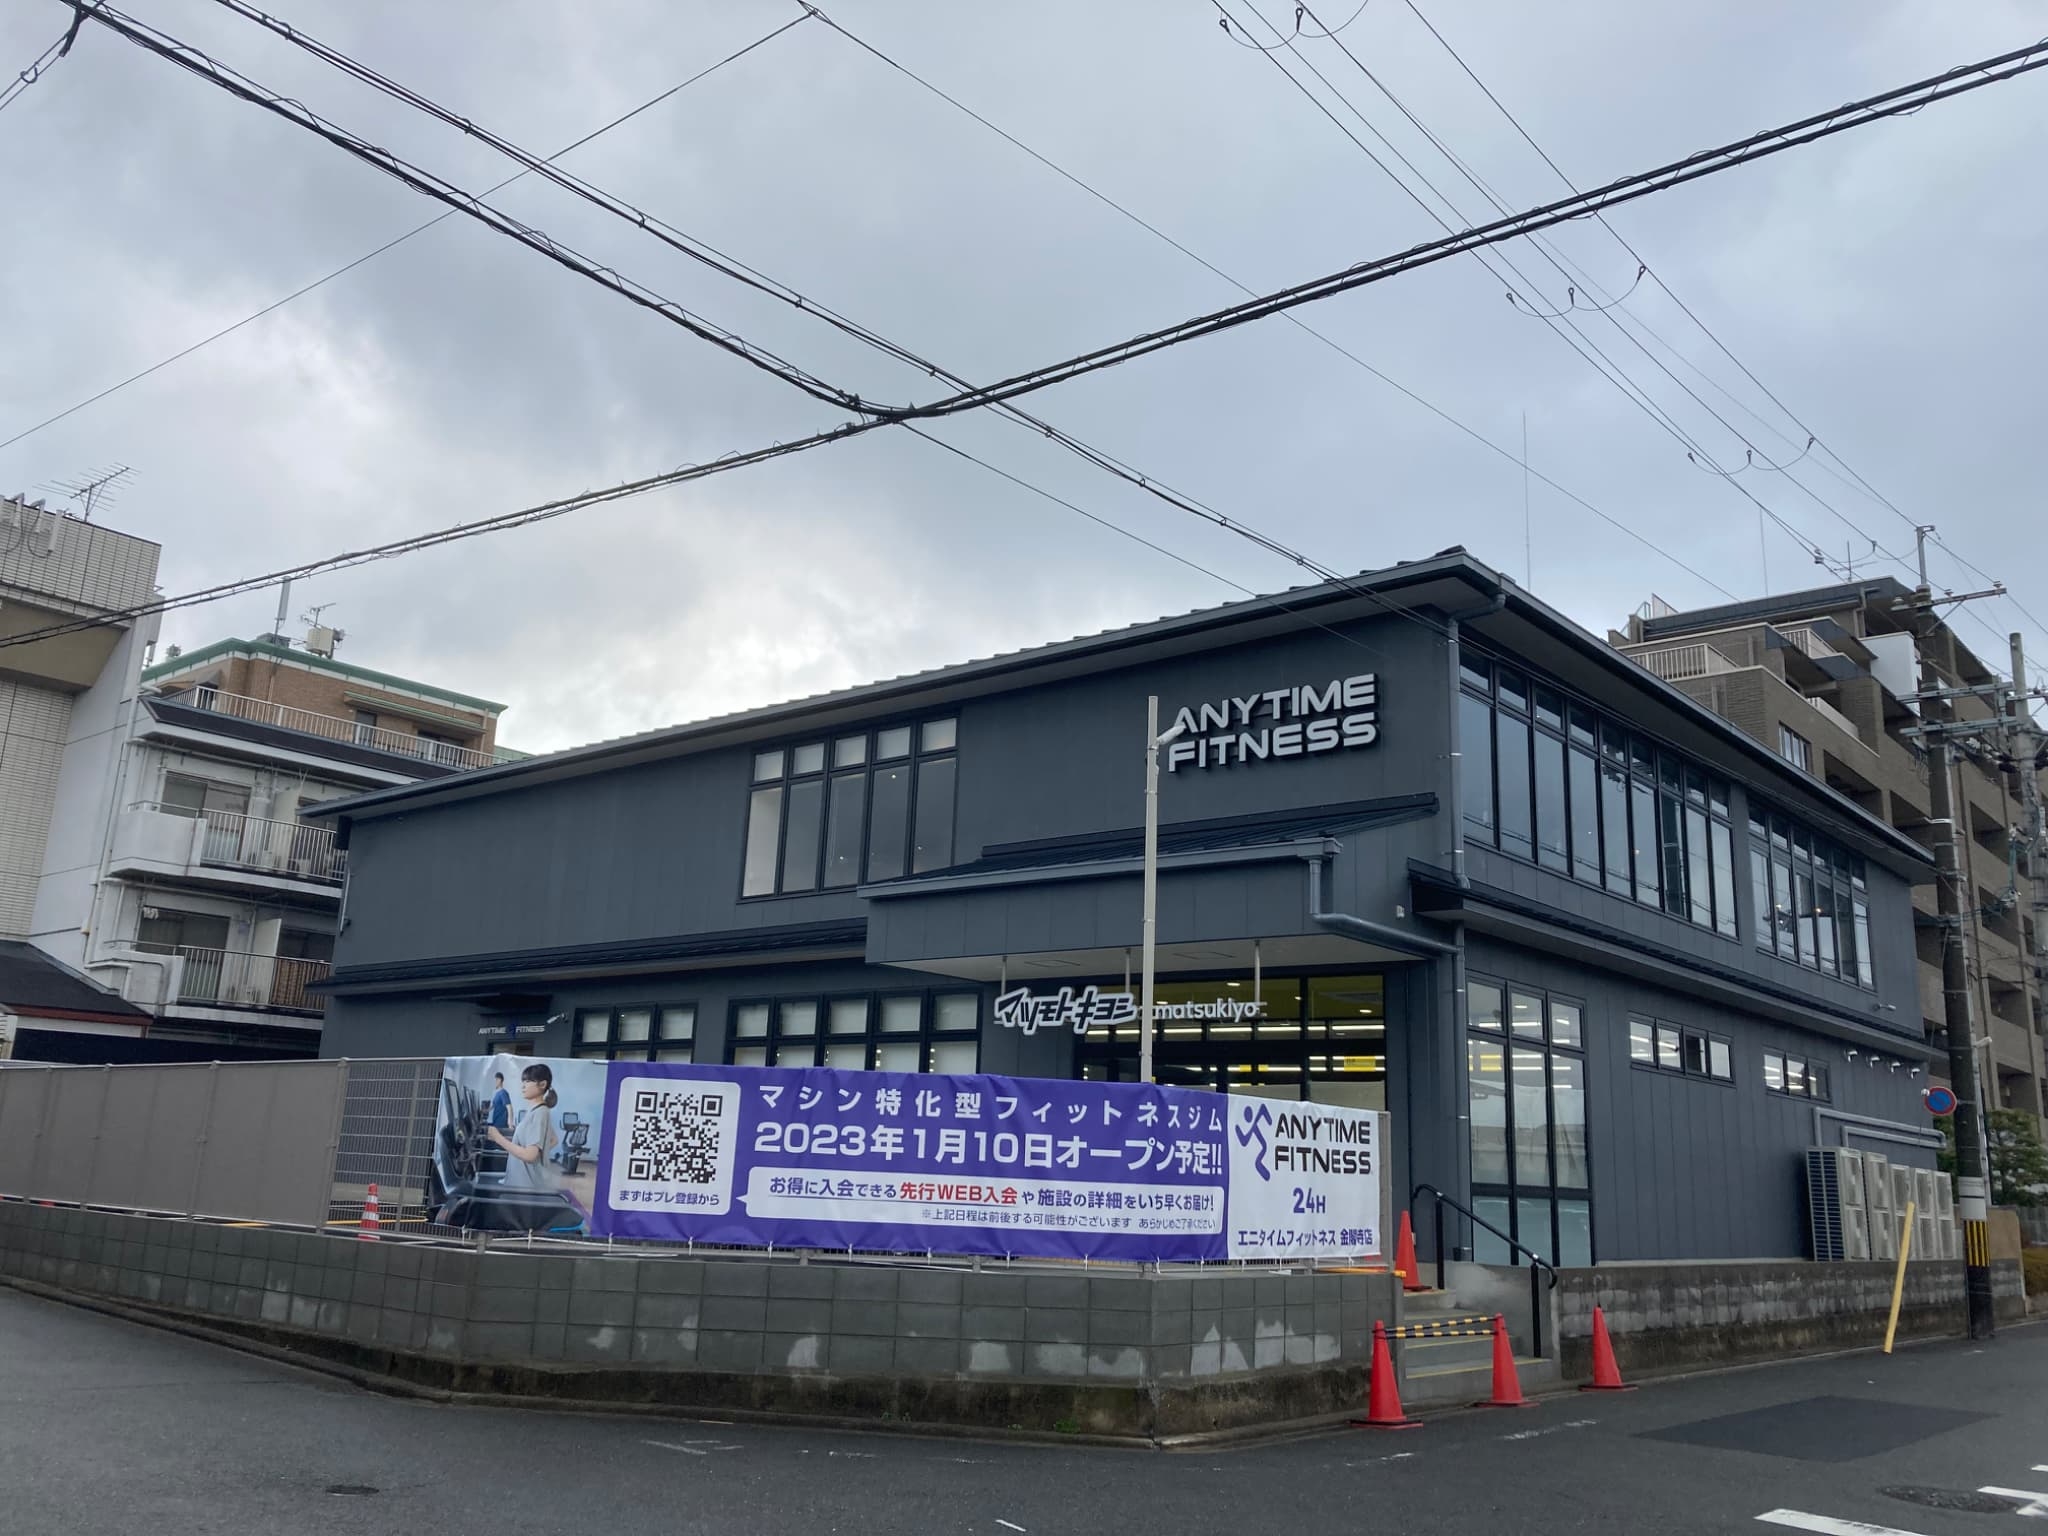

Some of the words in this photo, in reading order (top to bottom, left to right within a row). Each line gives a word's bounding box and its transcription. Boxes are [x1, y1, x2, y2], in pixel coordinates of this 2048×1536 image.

[1174, 673, 1375, 735] ANYTIME
[1168, 712, 1376, 772] FITNESS
[995, 987, 1137, 1035] マツモトキヨシ
[1154, 998, 1257, 1022] matsukiyo
[759, 1085, 1222, 1132] マシン特化型フィットネスジム
[1275, 1113, 1371, 1144] ANYTIME
[1275, 1145, 1371, 1174] FITNESS
[619, 1190, 720, 1206] まずはプレ登録から
[1293, 1187, 1326, 1214] 24H
[1238, 1229, 1336, 1246] エニタイムフィットネス
